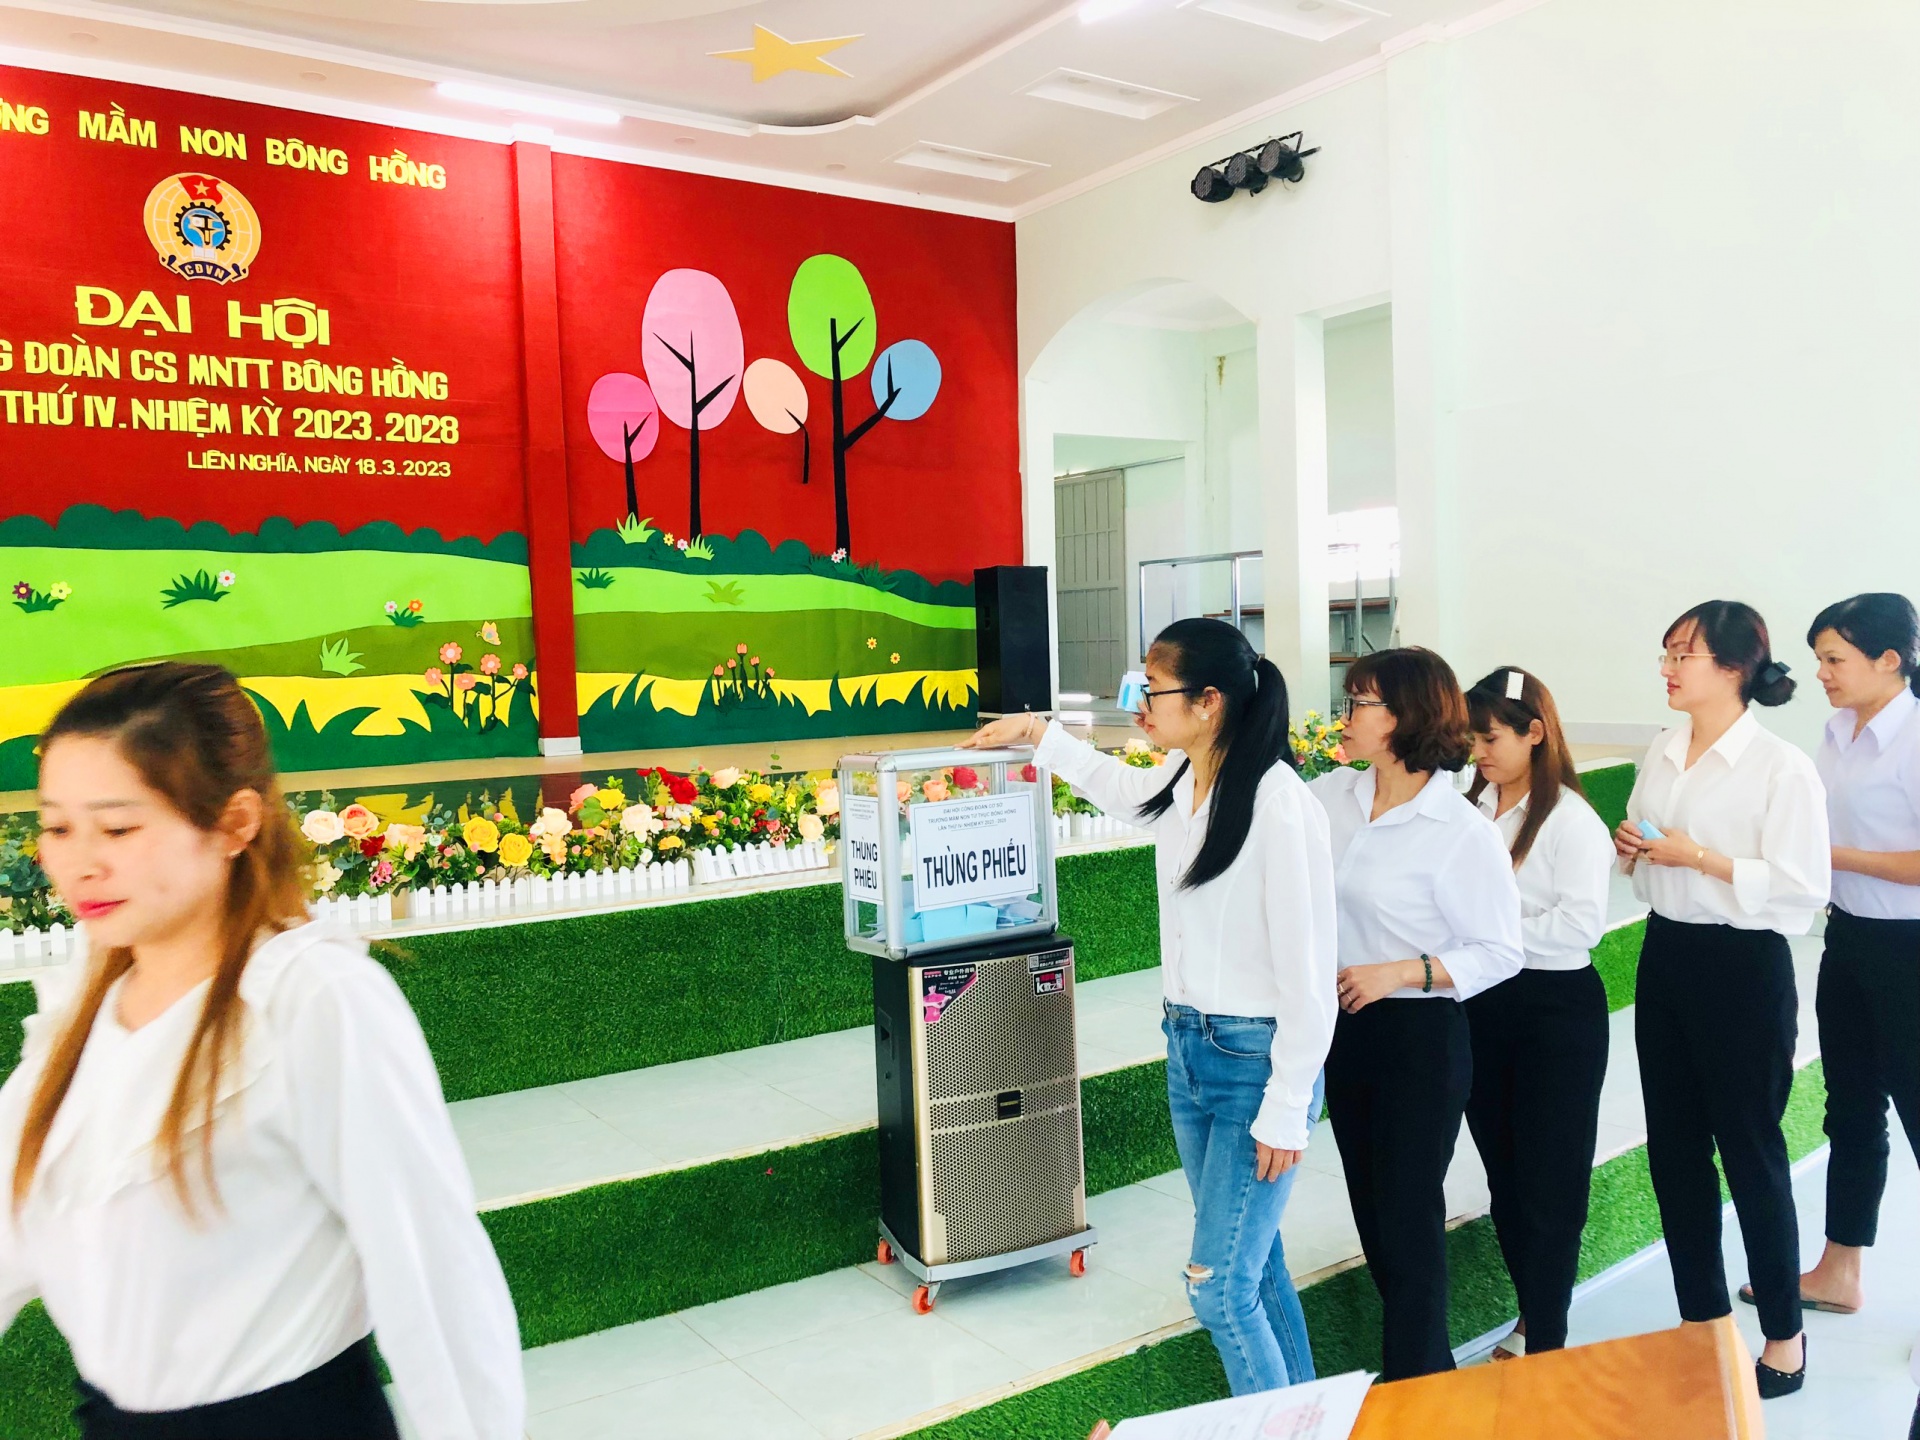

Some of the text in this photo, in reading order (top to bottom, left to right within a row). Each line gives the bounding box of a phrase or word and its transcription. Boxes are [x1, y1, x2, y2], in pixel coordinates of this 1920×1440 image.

[0, 97, 447, 190] NG MẦM NON BÔNG HỒNG
[184, 263, 225, 279] CĐVN
[75, 285, 331, 349] ĐẠI HỘI
[24, 333, 121, 379] ĐOÀN
[130, 349, 178, 382] CS
[189, 354, 274, 390] MNTT
[282, 358, 364, 396] BÔNG
[371, 357, 449, 401] HỒNG
[0, 382, 78, 426] THỨ
[242, 396, 284, 436] KỲ
[187, 450, 236, 471] LIÊN
[304, 454, 351, 474] NGÀY
[851, 836, 878, 862] THÙNG
[923, 838, 1026, 889] THÙNG PHIẾU
